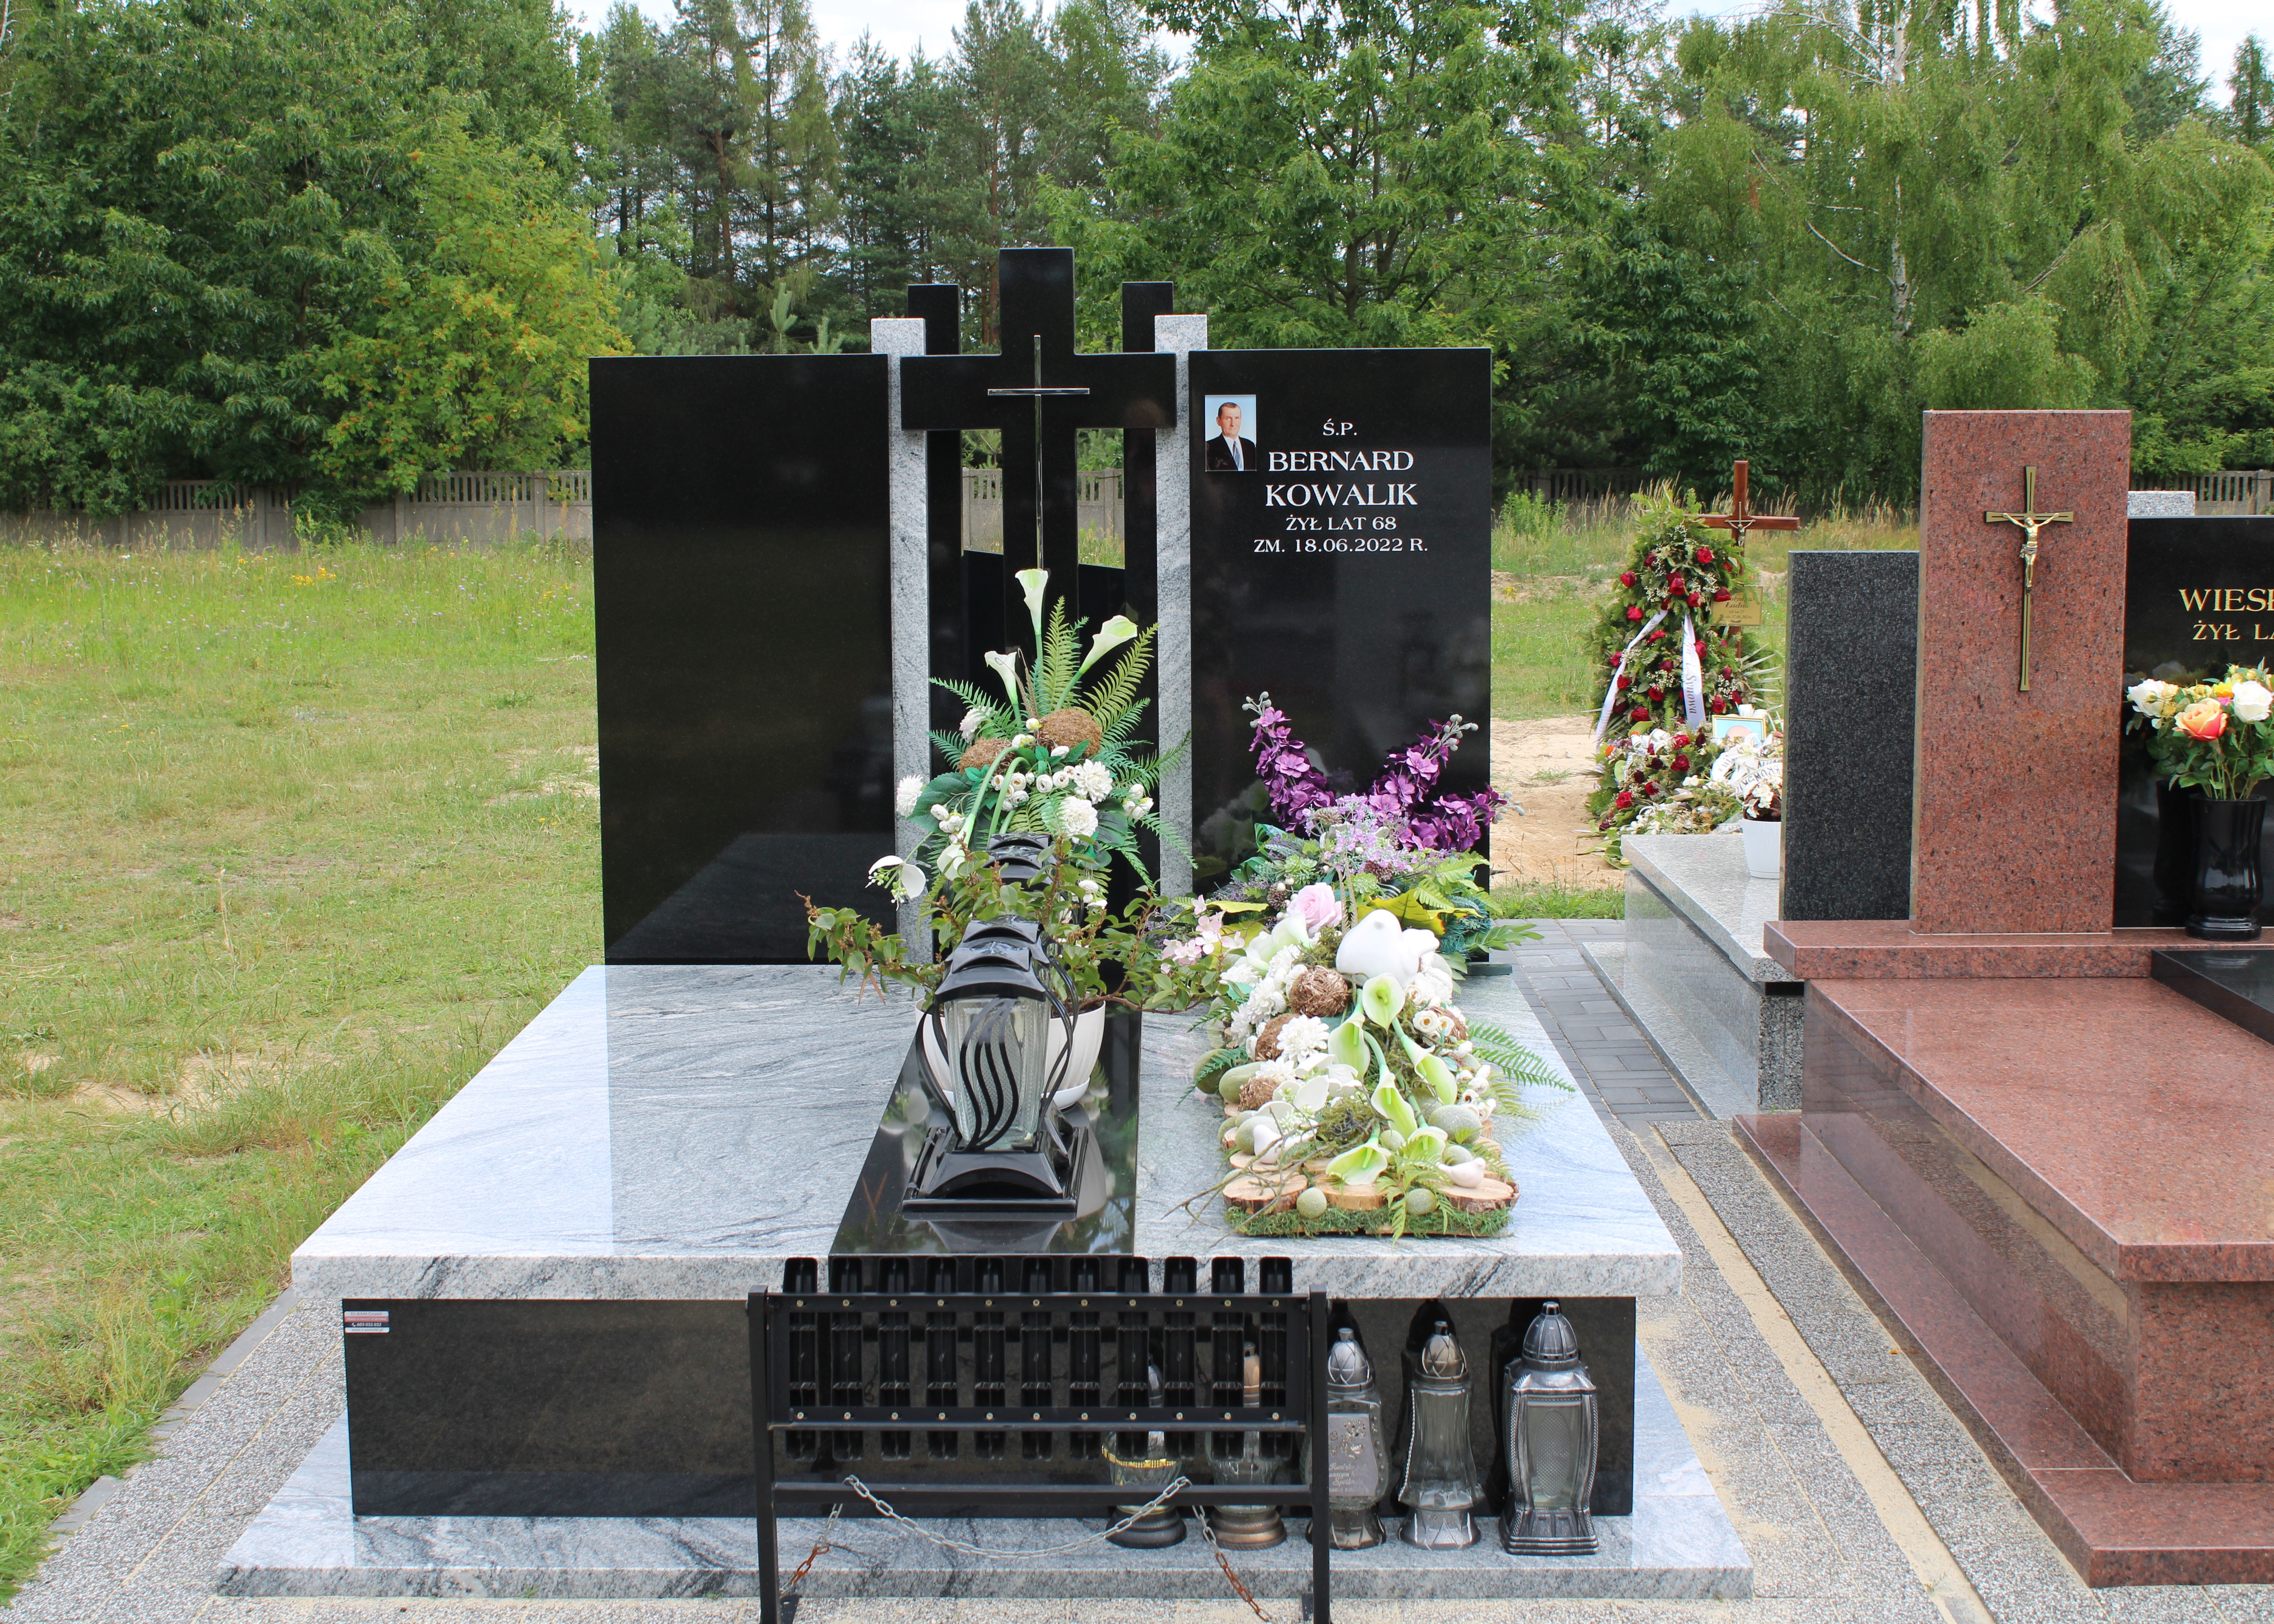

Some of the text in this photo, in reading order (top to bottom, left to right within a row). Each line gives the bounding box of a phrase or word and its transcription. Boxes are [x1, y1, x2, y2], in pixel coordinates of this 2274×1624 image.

[1323, 418, 1357, 436] Ś.P.
[1269, 451, 1414, 472] BERNARD
[1265, 483, 1418, 507] KOWALIK
[1286, 514, 1397, 530] ŻYŁ LAT 68
[1254, 538, 1428, 552] ZM. 18.06.2022 R.
[2193, 620, 2241, 640] ŻYŁ
[1684, 674, 1697, 715] Synowa
